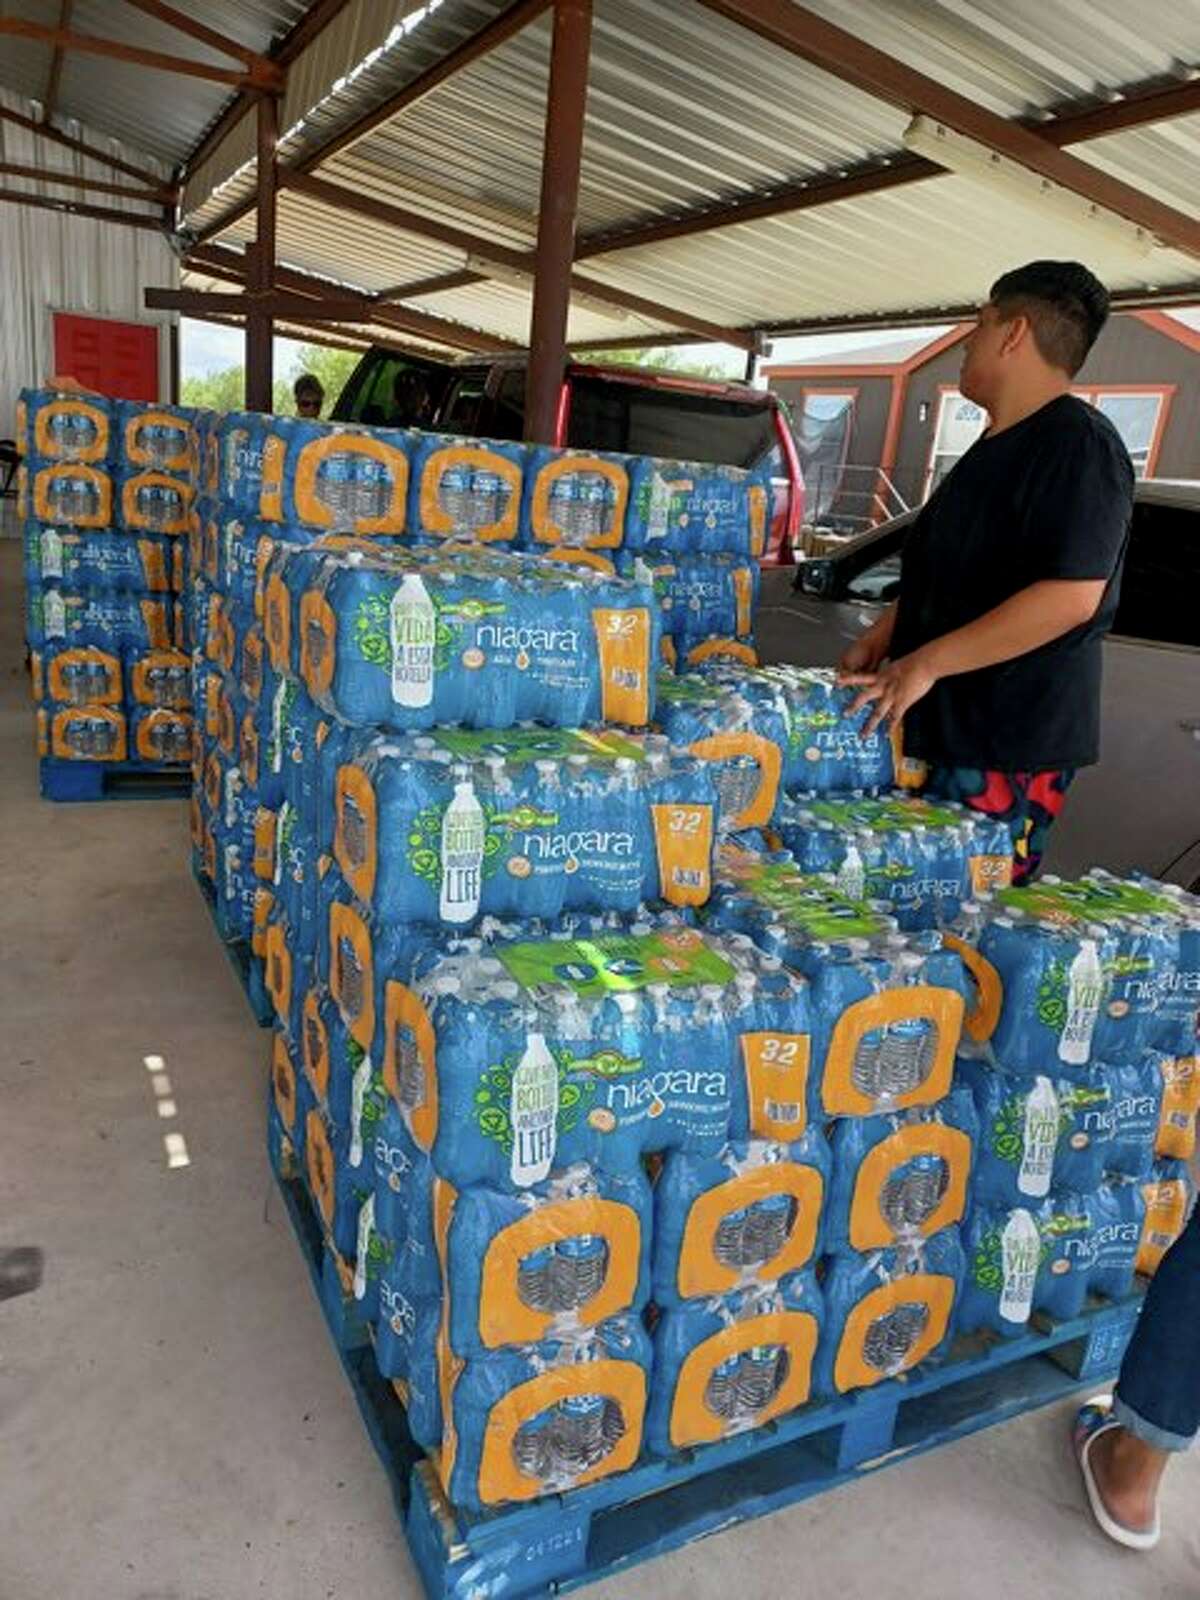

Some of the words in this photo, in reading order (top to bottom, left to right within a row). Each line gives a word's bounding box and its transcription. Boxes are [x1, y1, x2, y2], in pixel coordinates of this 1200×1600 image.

[607, 615, 638, 637] 32
[476, 624, 579, 667] niagara
[669, 810, 702, 833] 32
[523, 829, 634, 874] niagara
[979, 861, 1007, 877] 32
[760, 1039, 799, 1064] 32
[606, 1069, 726, 1118] niagara
